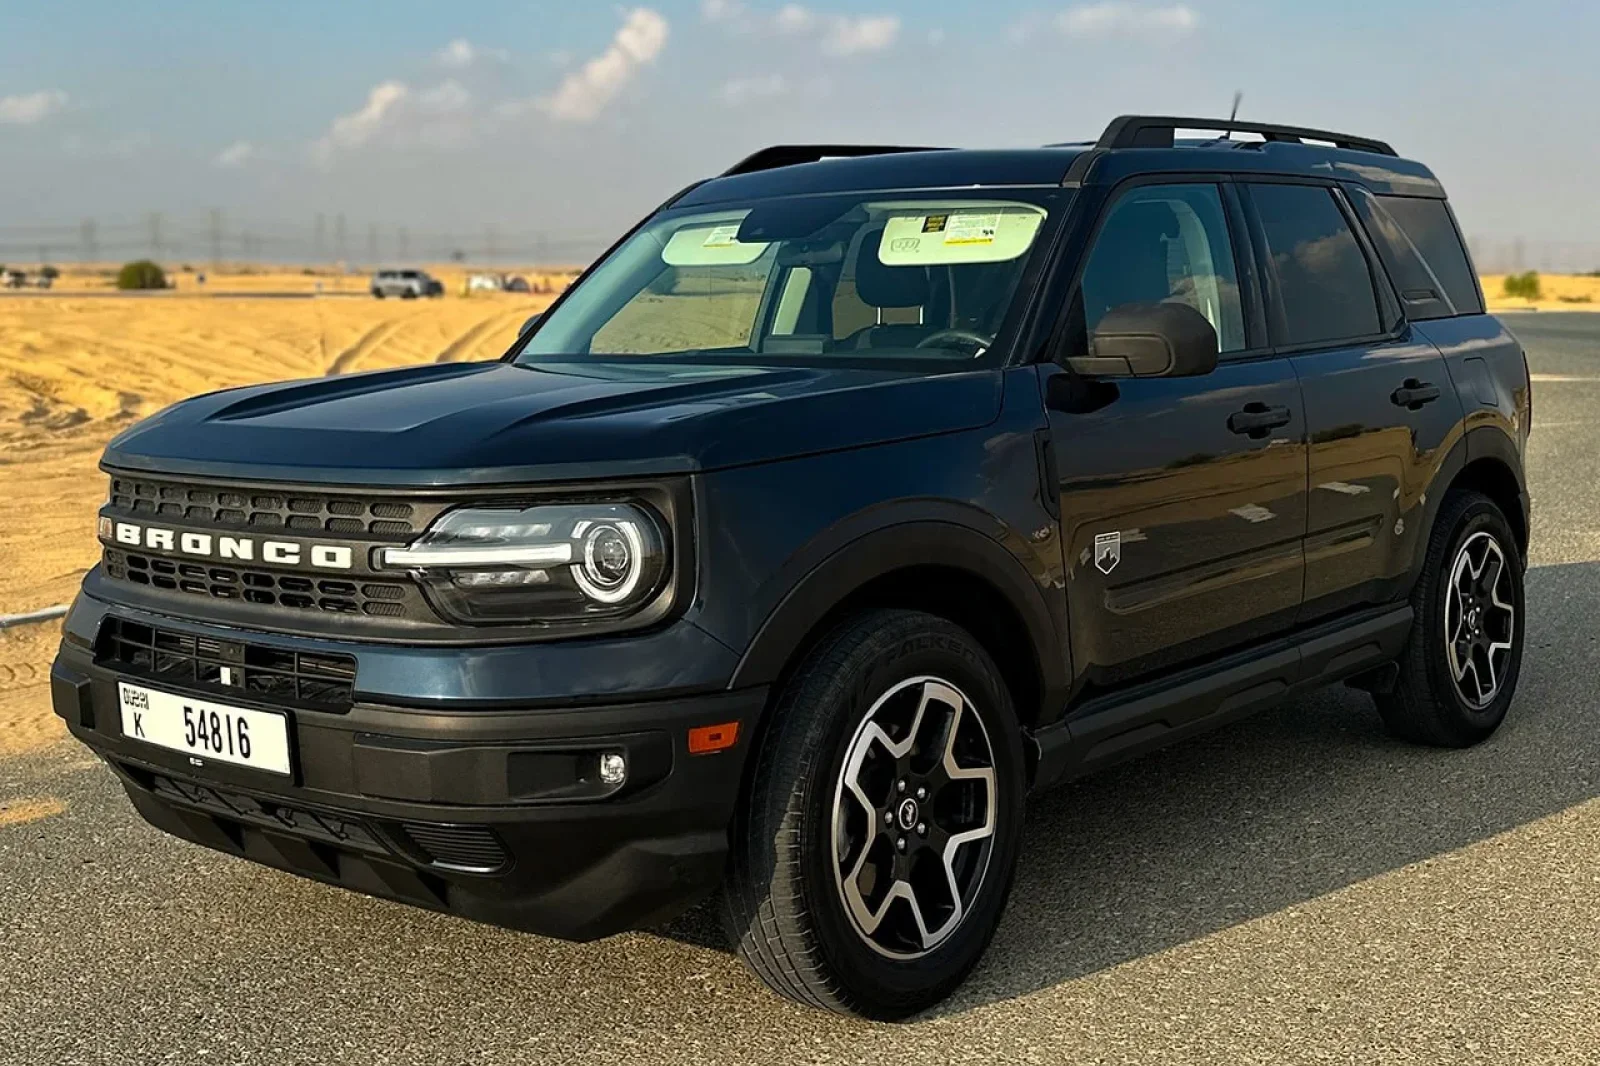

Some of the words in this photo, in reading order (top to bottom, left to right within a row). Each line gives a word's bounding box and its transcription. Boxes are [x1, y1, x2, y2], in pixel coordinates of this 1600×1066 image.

[116, 522, 353, 569] BRONCO
[134, 712, 145, 738] K
[184, 706, 251, 759] 54816
